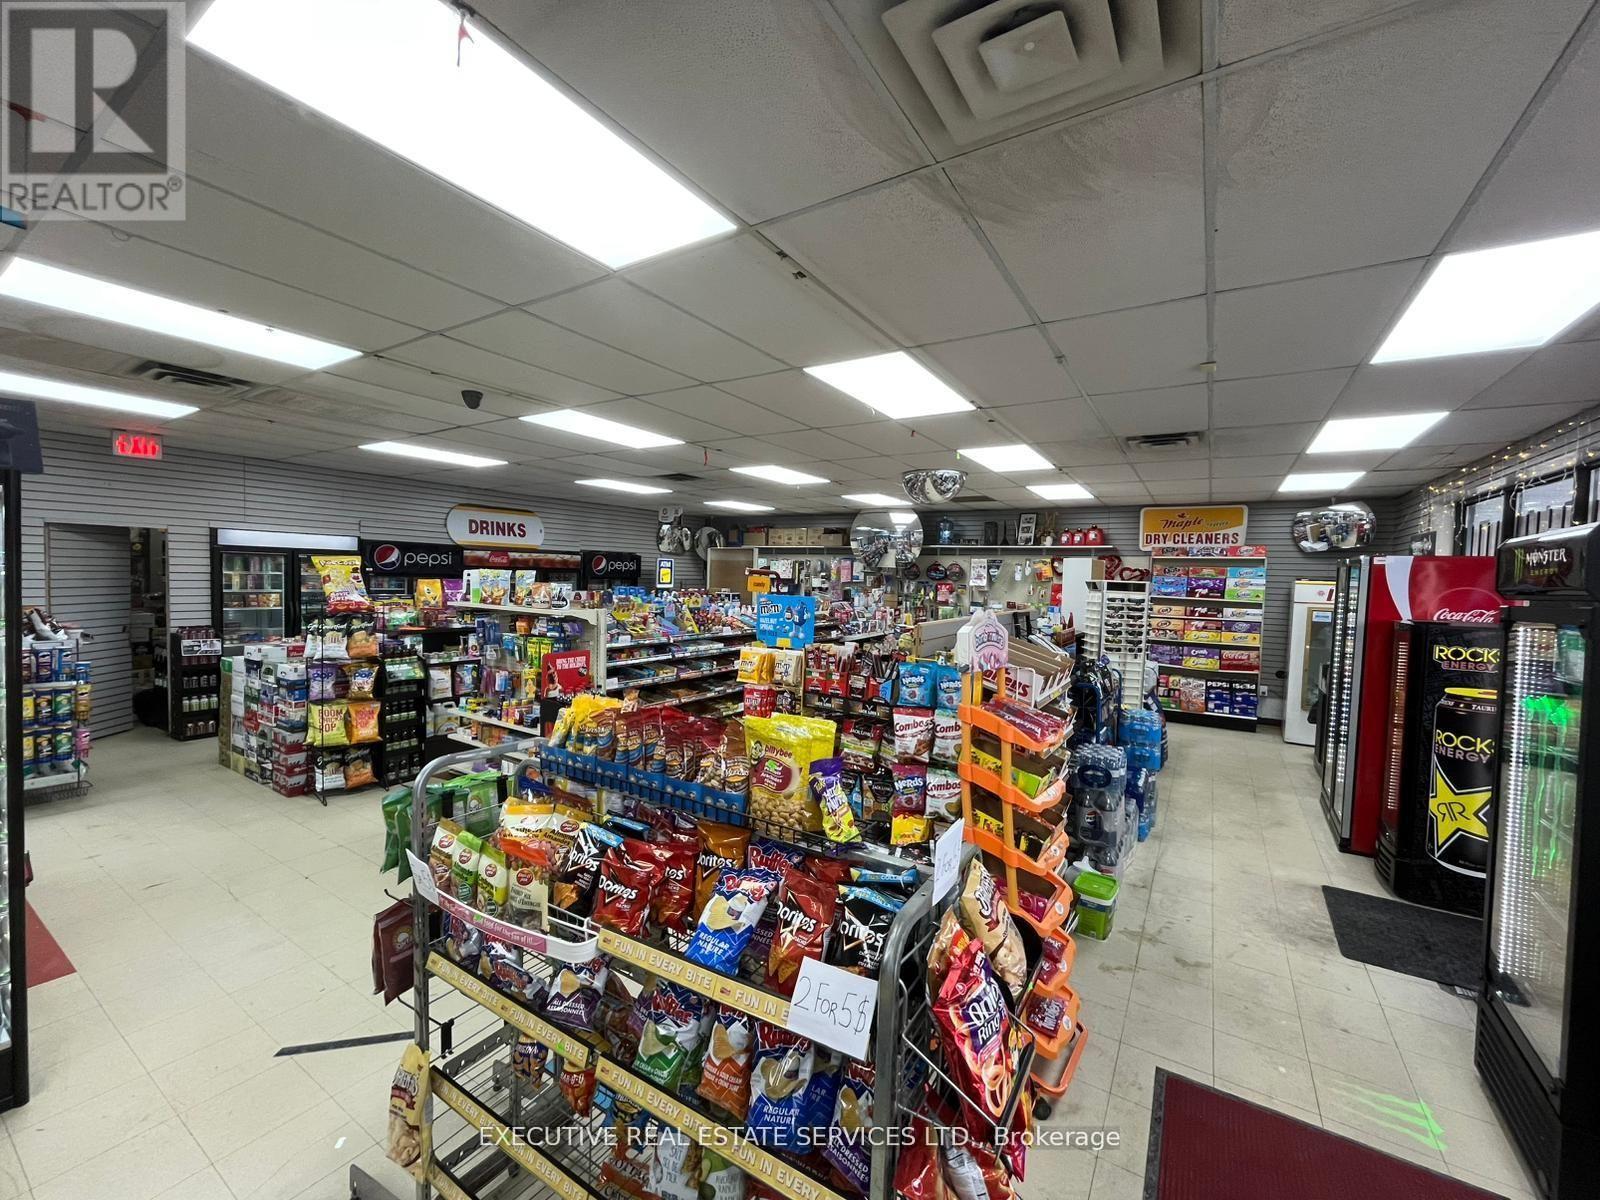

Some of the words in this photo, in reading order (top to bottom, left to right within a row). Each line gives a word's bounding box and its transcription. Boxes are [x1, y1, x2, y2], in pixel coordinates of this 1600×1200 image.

[468, 518, 527, 538] DRINKS
[1145, 533, 1169, 545] DRY
[1172, 532, 1240, 545] CLEANERS
[404, 551, 452, 567] pepsi
[607, 559, 637, 572] pepsi
[1525, 548, 1567, 566] MONSTER
[1432, 607, 1500, 624] Coca-Cola
[1433, 644, 1500, 665] ROCK
[1441, 660, 1496, 672] ENERGY
[935, 721, 961, 734] Comb
[1435, 729, 1495, 754] ROCK
[1434, 744, 1491, 764] ENERGY
[749, 845, 794, 877] Ruffle
[598, 874, 639, 899] Doritos
[698, 931, 730, 950] REGULAR
[840, 920, 884, 947] oritos
[613, 940, 634, 956] FUN
[633, 946, 646, 962] IN
[649, 954, 684, 979] EVERY
[686, 968, 713, 990] BITE
[438, 962, 451, 976] FUN
[460, 976, 481, 993] EVERY
[481, 990, 499, 1007] BITE
[794, 976, 812, 1012] 2
[562, 1001, 585, 1010] DESSED
[735, 990, 760, 1008] FUN
[763, 1000, 777, 1016] IN
[509, 1006, 526, 1023] FUN
[526, 1018, 535, 1031] IN
[537, 1026, 562, 1047] EVERY
[564, 1041, 585, 1060] BITE
[612, 1072, 633, 1091] FUN
[633, 1084, 645, 1099] IN
[647, 1092, 681, 1118] EVERY
[763, 1104, 800, 1116] REGULAR
[536, 1160, 562, 1185] EVERY
[563, 1179, 588, 1200] BITE
[731, 1144, 757, 1166] FUN
[759, 1160, 774, 1176] IN
[776, 1168, 821, 1200] EVERY
